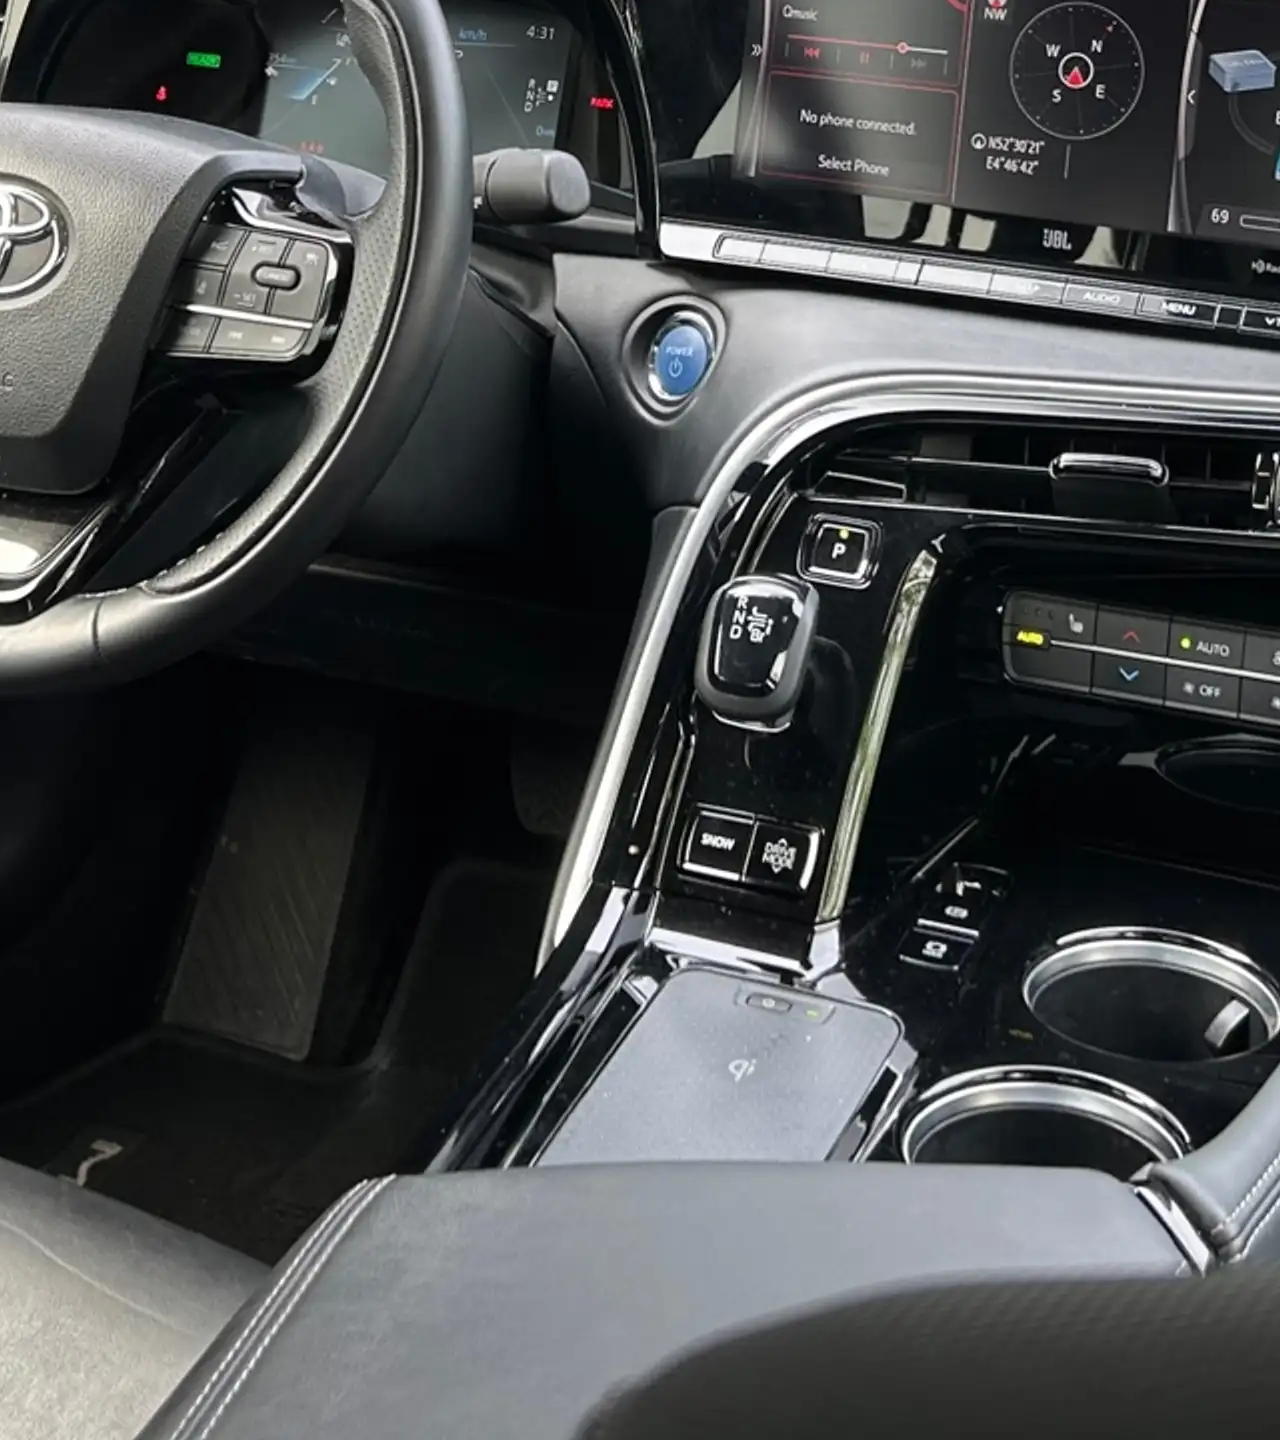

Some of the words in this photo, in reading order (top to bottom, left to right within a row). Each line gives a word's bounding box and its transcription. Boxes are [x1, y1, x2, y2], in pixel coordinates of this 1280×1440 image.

[782, 4, 818, 21] Qmusic
[984, 8, 1008, 21] NW
[526, 25, 555, 40] 4:31
[1046, 44, 1061, 58] W
[1091, 40, 1103, 53] N
[1051, 89, 1062, 103] S
[1095, 84, 1106, 100] E
[800, 108, 818, 124] No
[819, 112, 854, 128] phone
[856, 119, 917, 136] connected.
[818, 154, 852, 172] Select
[854, 158, 889, 177] Phone
[1211, 208, 1230, 224] 69
[1042, 227, 1072, 251] JBL
[1082, 290, 1121, 305] AUDIO
[1161, 301, 1198, 316] MENU
[832, 543, 847, 559] P
[737, 596, 749, 609] R
[732, 610, 746, 625] N
[730, 624, 742, 639] D
[1196, 640, 1230, 657] AUTO
[1199, 684, 1221, 698] OFF
[701, 832, 735, 851] SNOW
